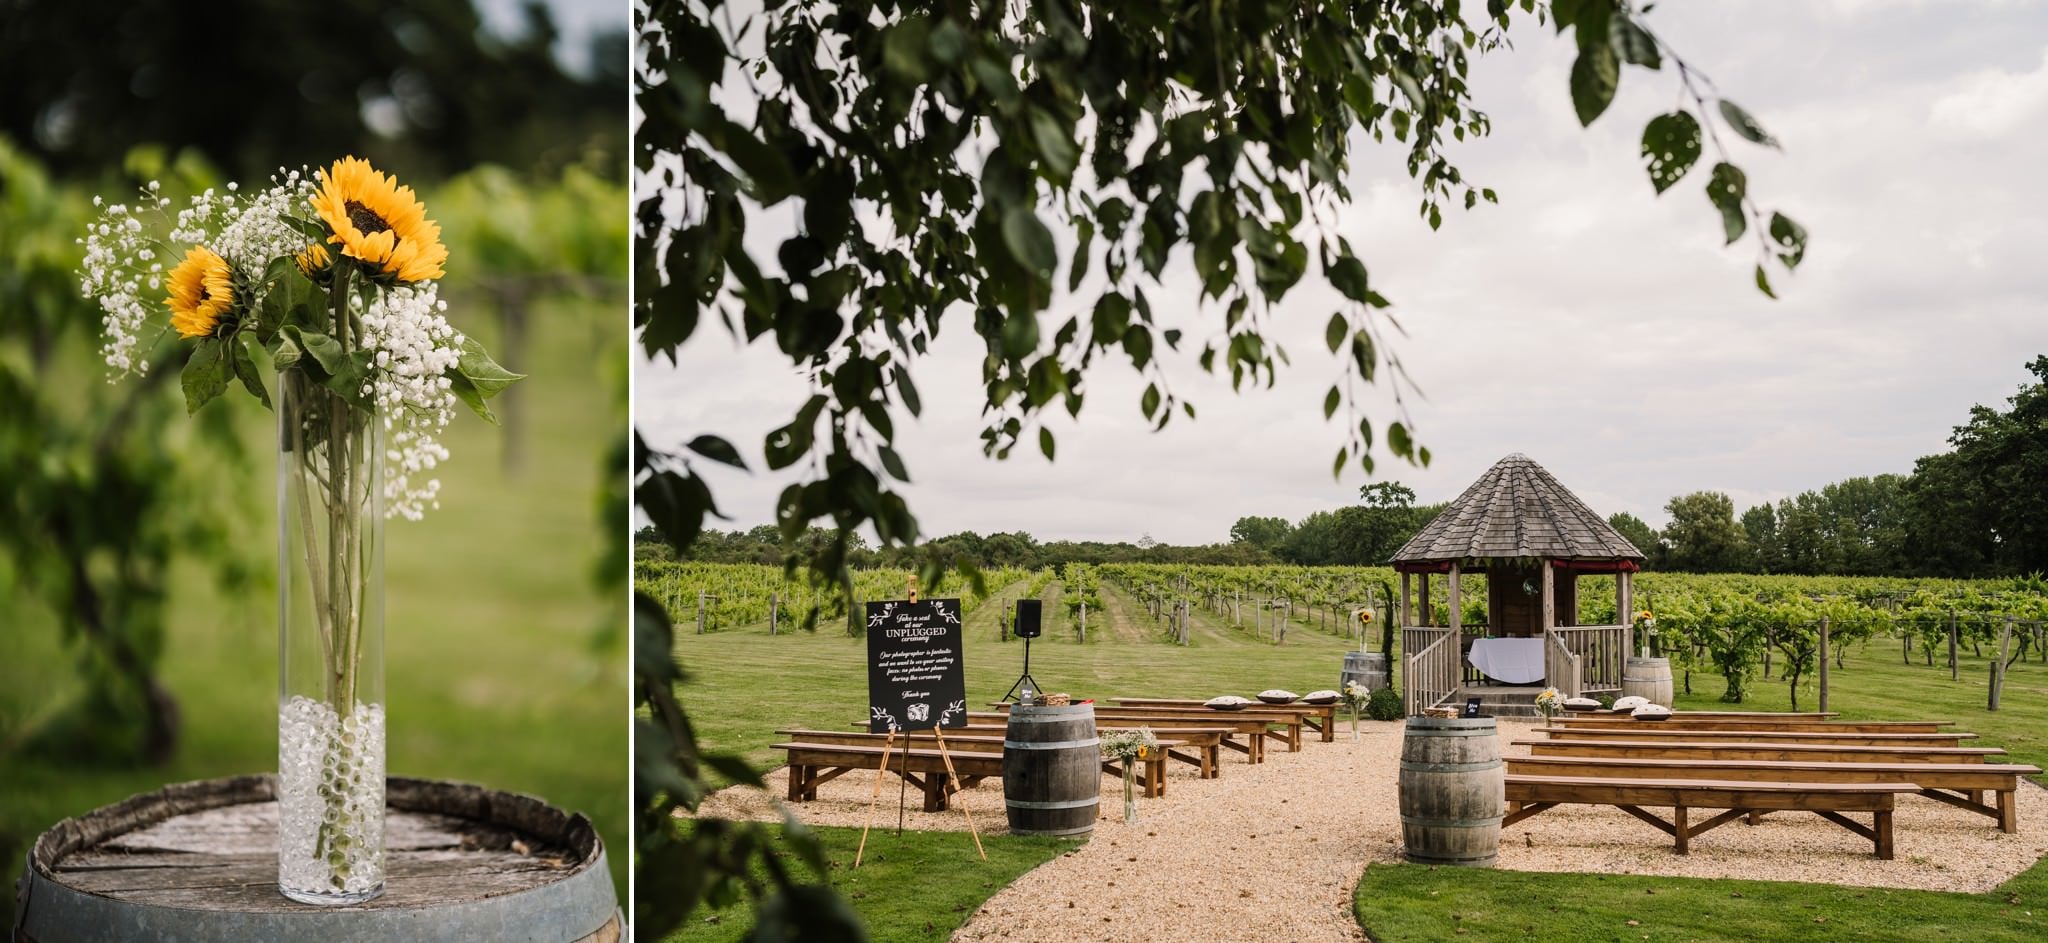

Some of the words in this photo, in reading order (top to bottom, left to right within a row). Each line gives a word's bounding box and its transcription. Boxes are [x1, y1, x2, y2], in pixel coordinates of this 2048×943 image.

[896, 614, 911, 623] Take
[919, 613, 931, 621] seat
[886, 628, 946, 637] UNPLUGGED
[880, 651, 891, 659] Our
[891, 650, 925, 658] photographer
[902, 690, 919, 699] Thank
[920, 691, 930, 699] you
